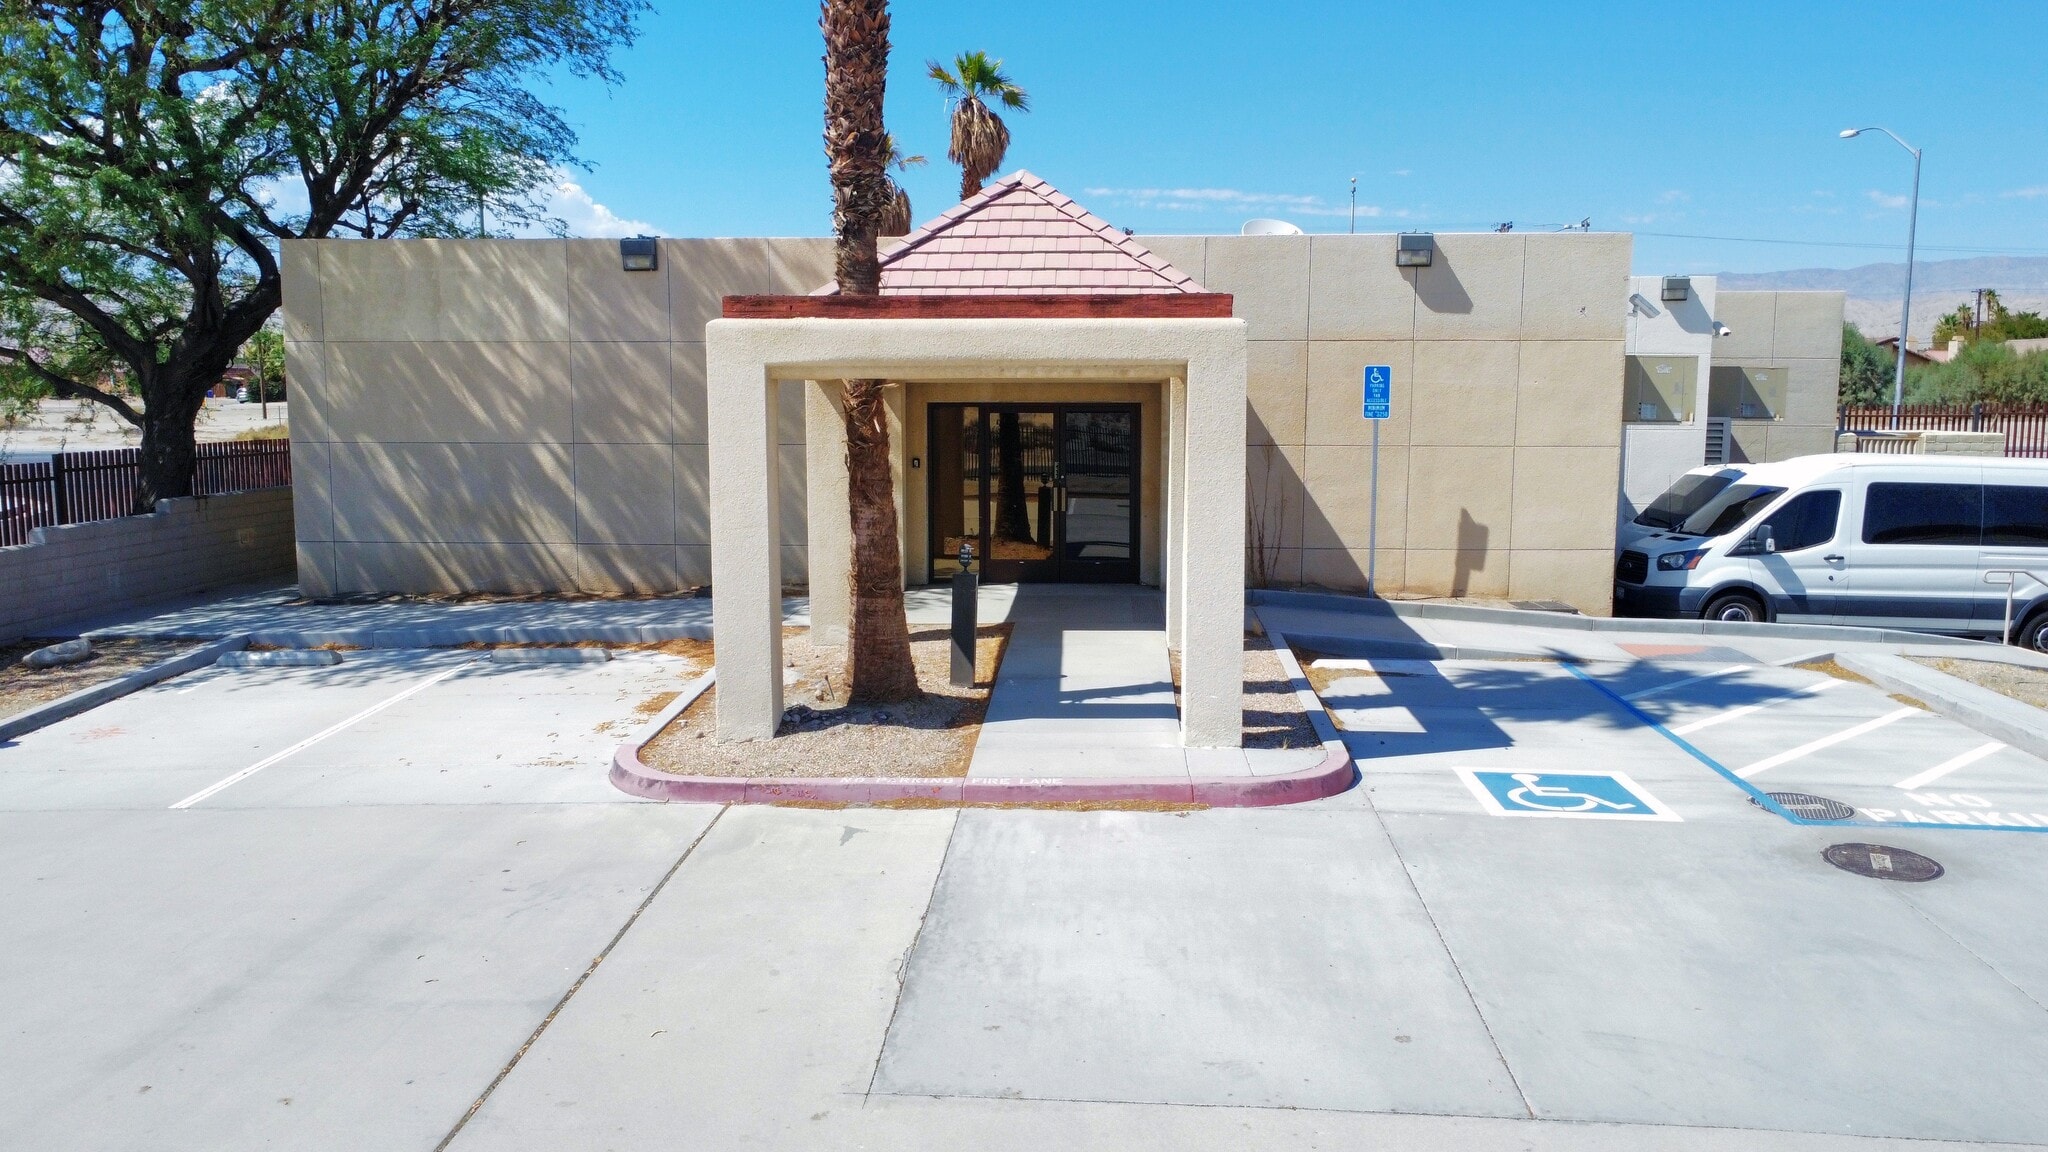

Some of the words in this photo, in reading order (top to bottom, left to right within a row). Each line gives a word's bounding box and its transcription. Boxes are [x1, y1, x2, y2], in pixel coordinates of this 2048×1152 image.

[972, 777, 1011, 785] FIRE
[1019, 777, 1064, 785] LANE
[1904, 793, 1992, 807] NO
